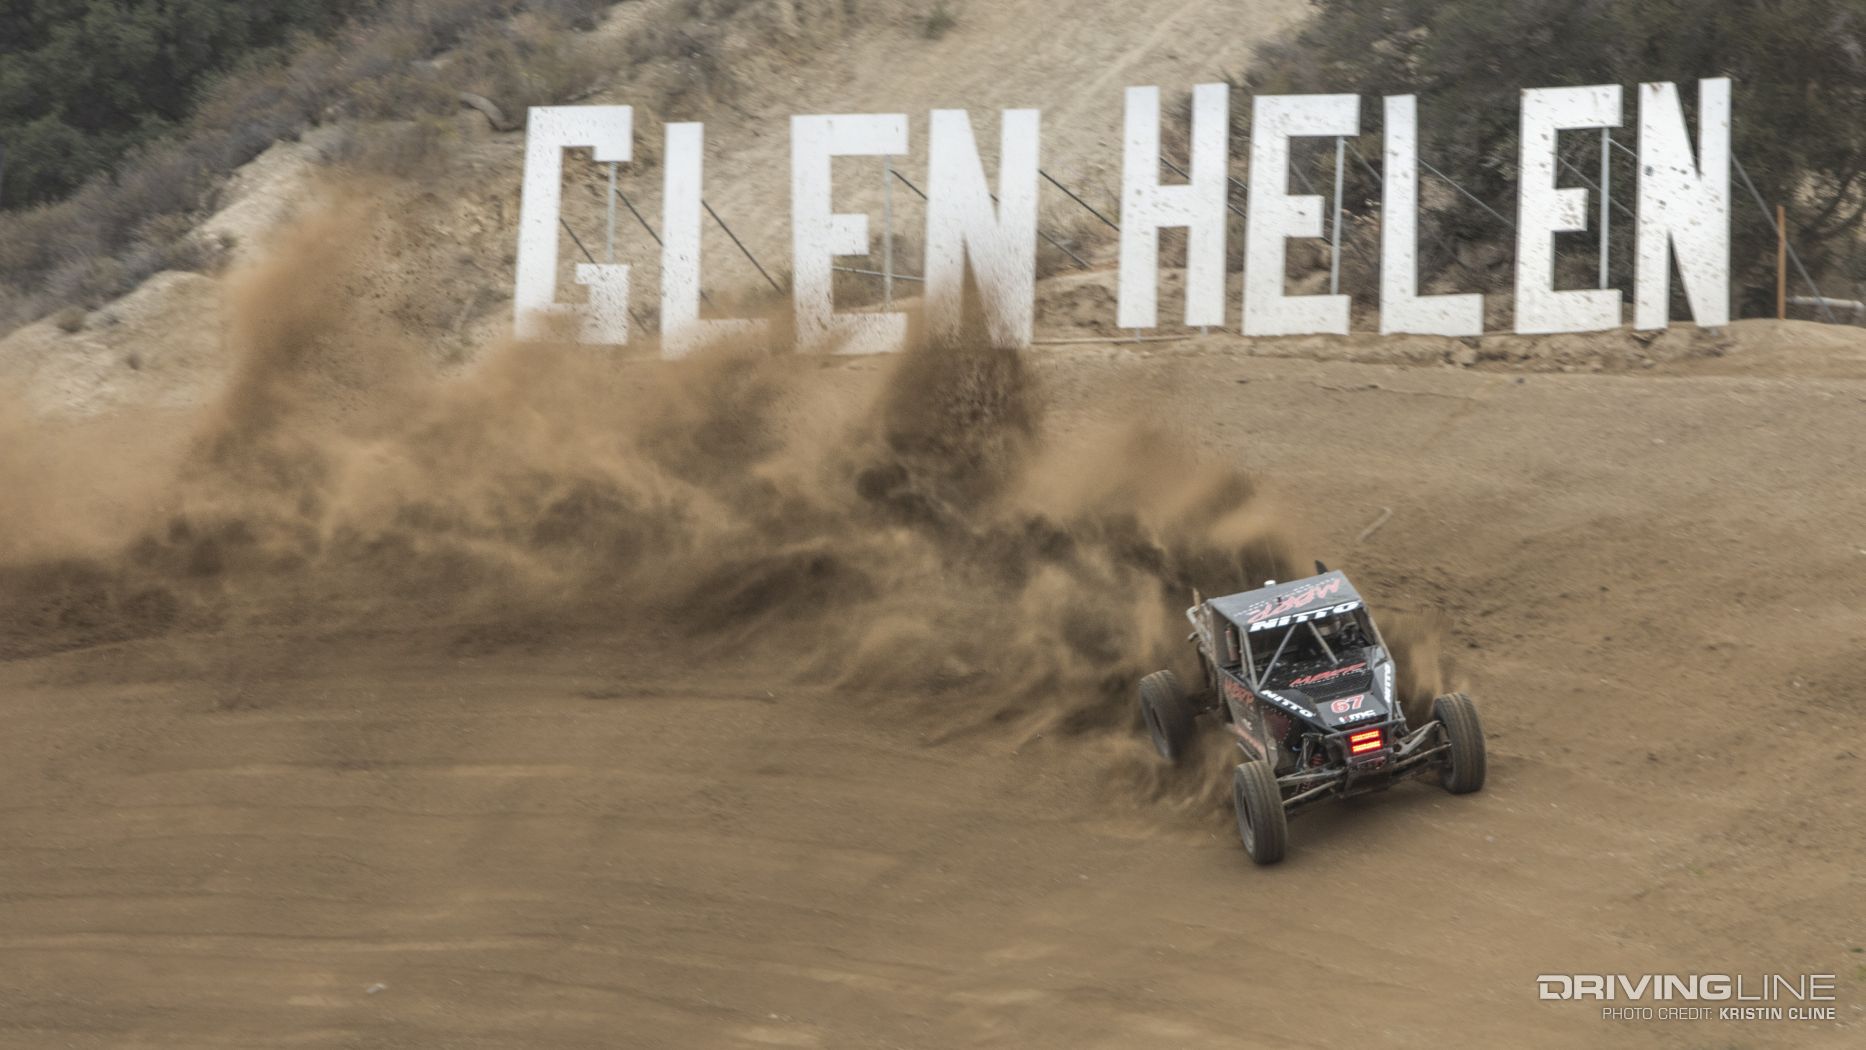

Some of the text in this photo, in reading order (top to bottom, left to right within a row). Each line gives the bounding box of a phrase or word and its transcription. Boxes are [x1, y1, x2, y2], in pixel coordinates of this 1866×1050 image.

[514, 77, 1731, 358] GLEN HELEN
[1249, 599, 1361, 632] NITTO
[1260, 689, 1315, 718] NITTO
[1331, 695, 1365, 713] 67
